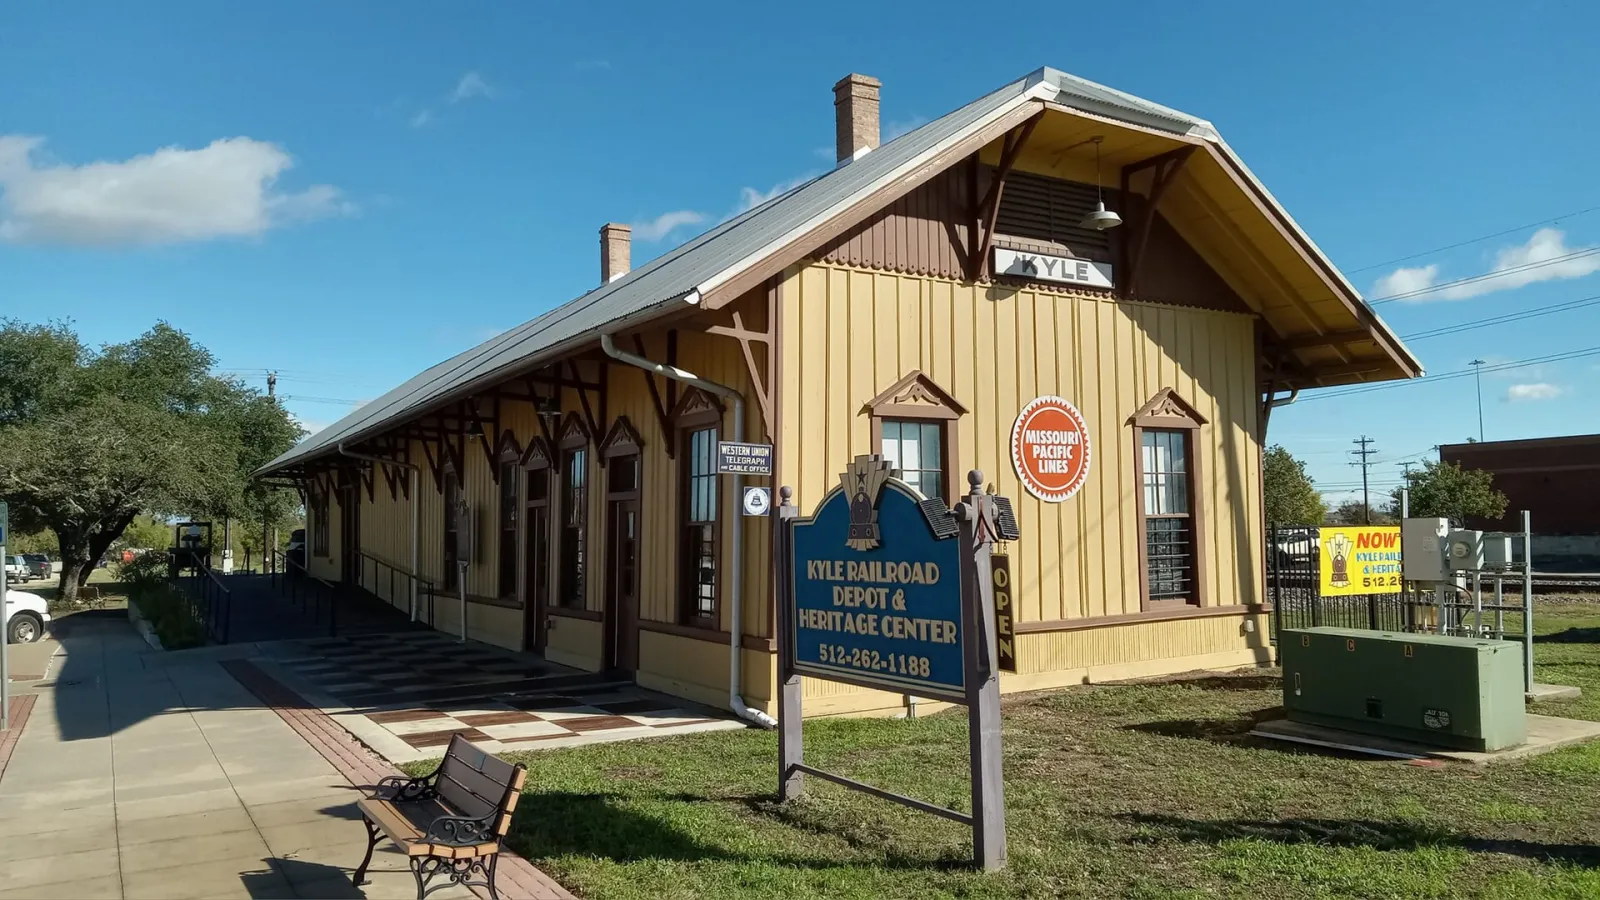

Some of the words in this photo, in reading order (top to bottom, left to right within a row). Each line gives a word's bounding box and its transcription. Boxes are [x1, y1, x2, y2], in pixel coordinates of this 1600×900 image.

[1021, 254, 1089, 281] KYLE
[1025, 430, 1080, 445] MISSOURI
[721, 445, 750, 455] WESTERN
[751, 447, 769, 456] UNION
[1032, 445, 1073, 460] PACIFIC
[725, 456, 765, 465] TELEGRAPH
[1038, 460, 1069, 474] LINES
[1356, 532, 1397, 549] NOW
[1356, 552, 1378, 562] KYLE
[807, 560, 845, 580] KYLE
[846, 561, 940, 585] RAILROAD
[1363, 565, 1370, 574] &
[832, 586, 890, 610] DEPOT
[892, 588, 907, 611] &
[994, 568, 1012, 659] OPEN
[798, 608, 880, 636] HERITAGE
[881, 615, 957, 645] CENTER
[819, 643, 931, 678] 512-262-1188
